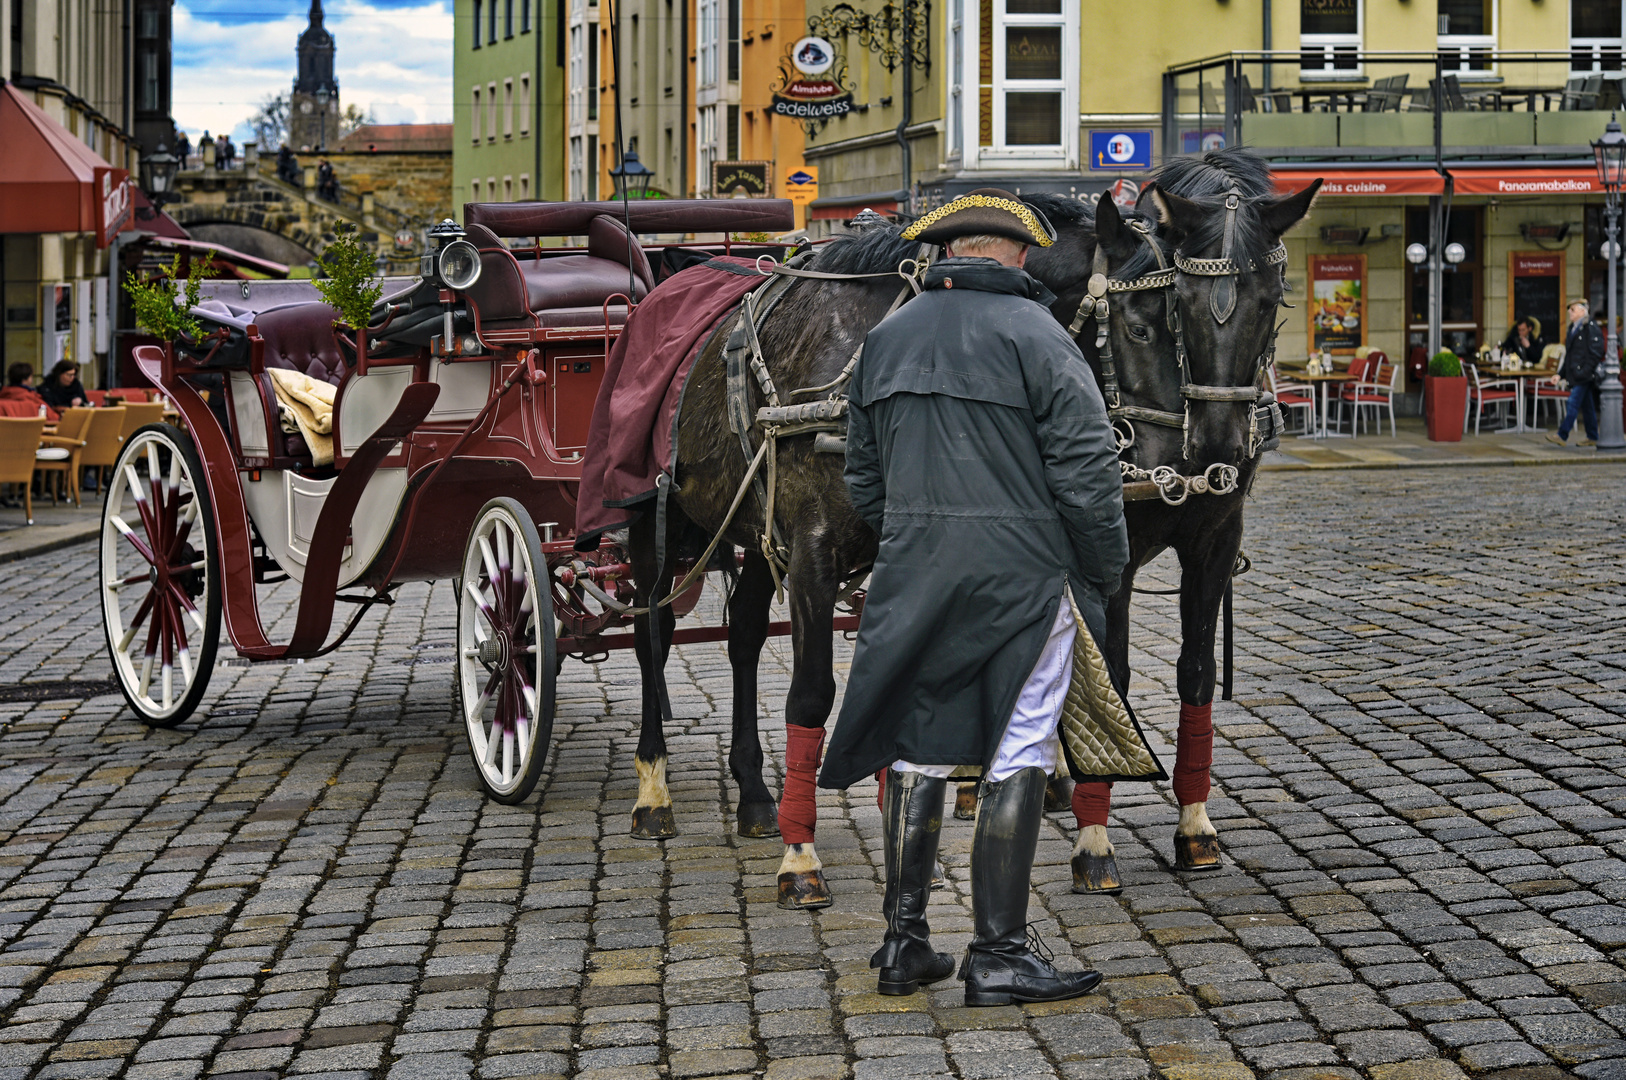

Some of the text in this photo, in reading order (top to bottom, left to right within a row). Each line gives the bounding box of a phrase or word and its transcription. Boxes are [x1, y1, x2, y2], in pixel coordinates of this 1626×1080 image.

[1009, 38, 1057, 55] ROYAL
[791, 84, 834, 94] Almstube
[776, 100, 850, 116] edelweiss
[980, 90, 991, 142] ROYAL
[717, 169, 764, 190] Las Tapas
[1498, 179, 1591, 191] Panoramabalkon
[1320, 182, 1387, 192] wiss cuisine
[1519, 260, 1554, 269] Schweizer
